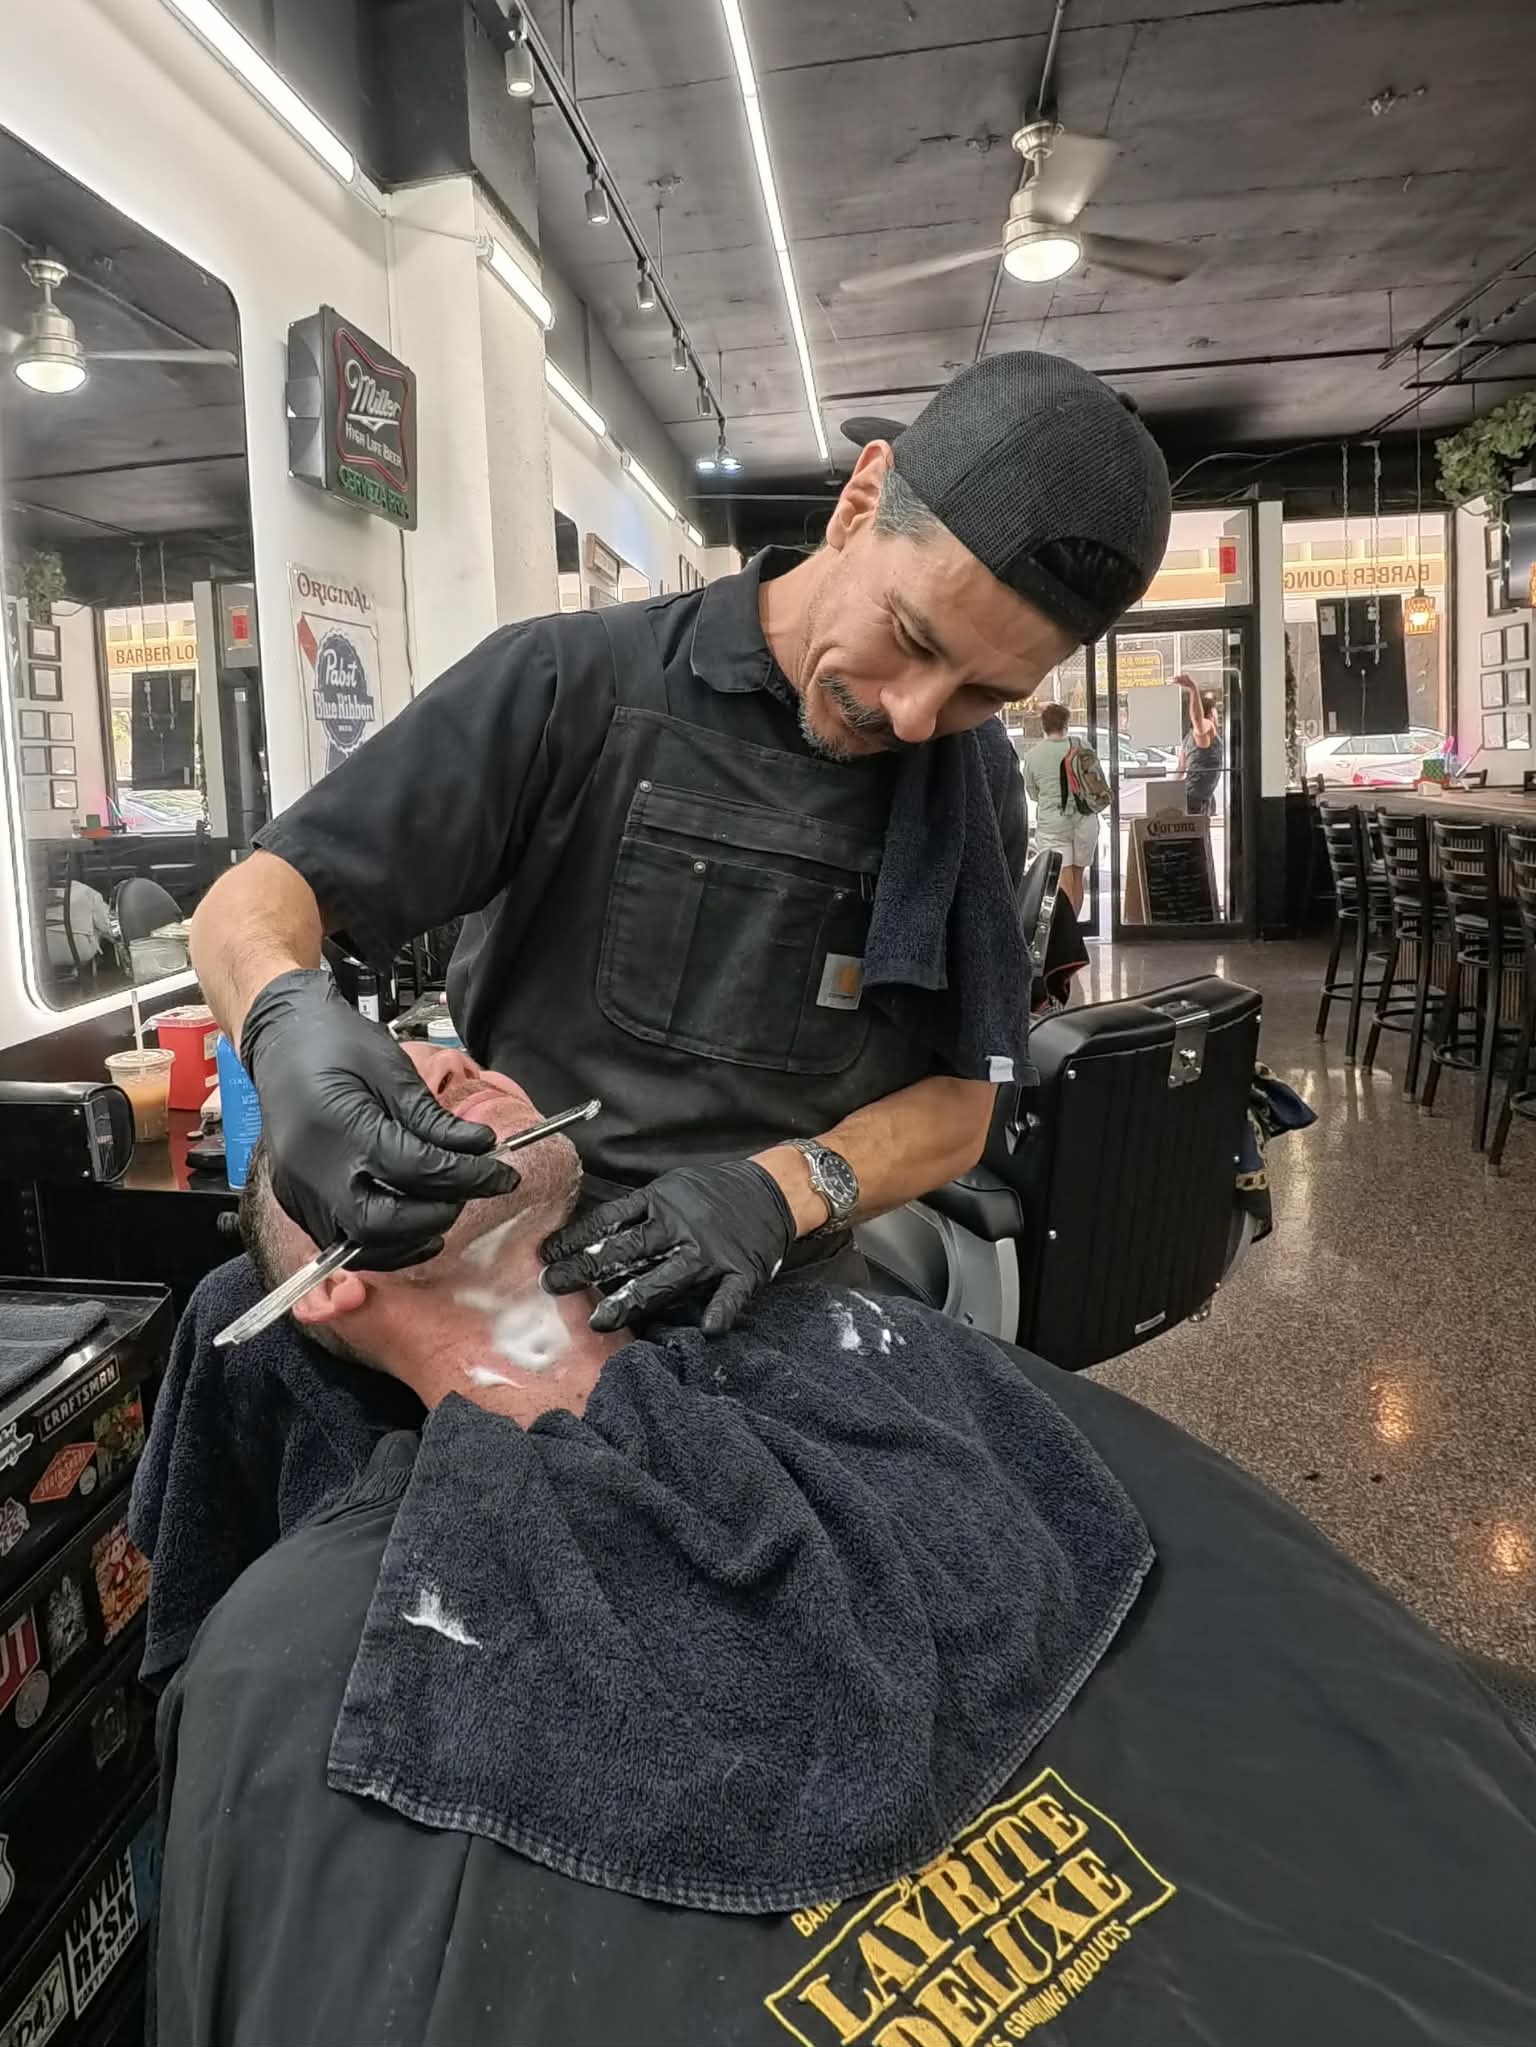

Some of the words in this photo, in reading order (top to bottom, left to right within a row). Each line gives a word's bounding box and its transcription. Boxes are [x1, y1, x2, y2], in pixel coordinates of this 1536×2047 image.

[345, 359, 401, 417] Miller
[297, 572, 371, 614] ORIGINAL
[116, 646, 171, 664] BARBER
[324, 649, 358, 688] Pabst
[314, 691, 338, 719] Blue
[338, 692, 374, 721] Ribbon
[1146, 820, 1196, 836] Corona
[43, 1362, 117, 1433] CRAFTSMAN
[798, 1793, 1089, 2045] LAYRITE
[1058, 1919, 1131, 1998] PRODUCTS
